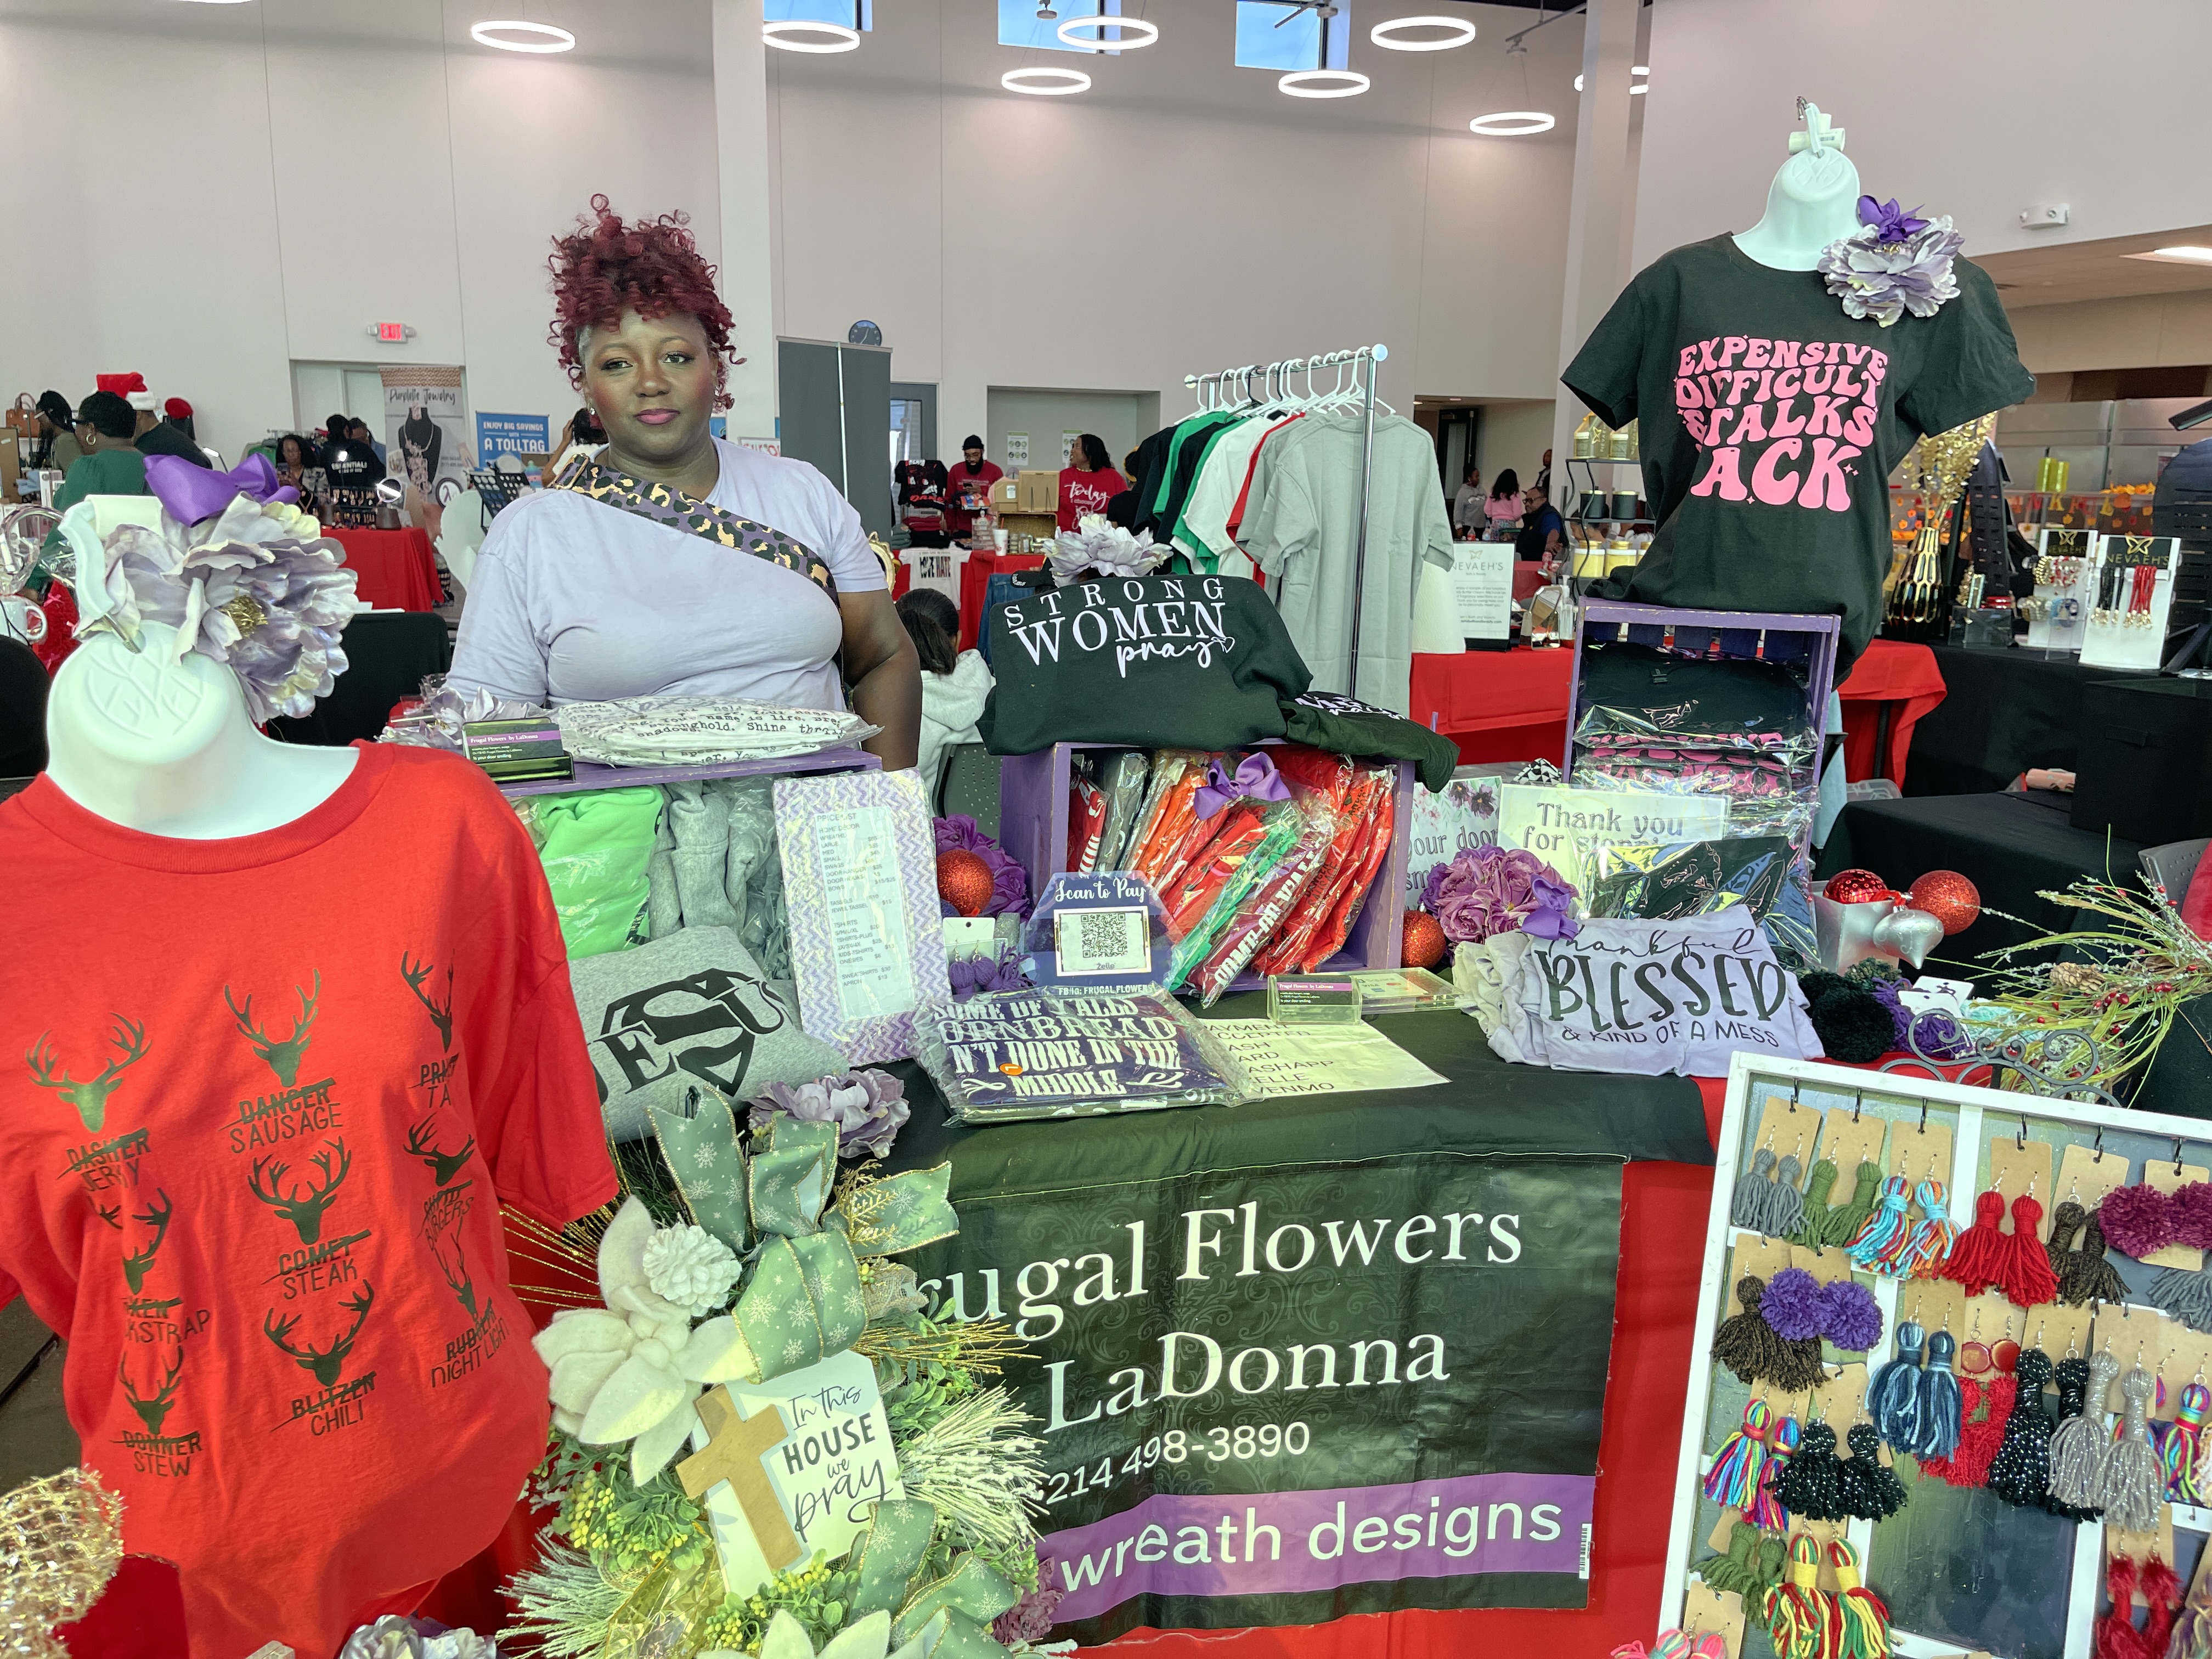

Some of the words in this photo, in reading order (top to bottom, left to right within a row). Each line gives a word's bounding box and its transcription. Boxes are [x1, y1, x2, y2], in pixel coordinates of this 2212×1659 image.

[381, 323, 402, 340] EXIT
[1677, 336, 1888, 380] EXPENSIVE
[1675, 364, 1877, 409] DIFFICULT
[483, 421, 503, 430] ENJOY
[504, 422, 515, 430] BIG
[516, 423, 544, 431] SAVINGS
[1703, 395, 1877, 448] TALKS
[484, 438, 493, 451] A
[495, 438, 545, 452] TOLLTAG
[1690, 437, 1863, 511] ACK
[1064, 482, 1110, 511] today
[2107, 554, 2169, 565] NEVAEH'S
[1004, 578, 1224, 629] STRONG
[1009, 601, 1226, 665] WOMEN
[1115, 635, 1215, 678] pray
[747, 722, 787, 732] Shine
[1537, 802, 1622, 834] Thank
[1632, 814, 1684, 840] you
[1457, 826, 1498, 850] door
[1523, 826, 1565, 852] for
[1055, 880, 1095, 902] Scan
[1093, 883, 1111, 899] to
[1113, 878, 1147, 903] Pay
[837, 933, 873, 943] TSHIRTS-PLUS
[839, 956, 864, 964] ONESIES
[843, 979, 862, 987] APRON
[1084, 986, 1115, 995] FRUGAL
[1535, 950, 1786, 1032] BLESSED
[937, 1018, 1178, 1043] ORNBREAD
[1217, 1031, 1311, 1040] CCEPTED
[1562, 1025, 1582, 1041] &
[1589, 1031, 1647, 1043] KIND
[1656, 1022, 1679, 1043] OF
[1690, 1024, 1706, 1041] A
[1716, 1023, 1780, 1047] MESS
[1003, 1040, 1087, 1072] DONE
[1087, 1039, 1124, 1064] IN
[1124, 1039, 1182, 1071] THE
[1229, 1042, 1271, 1051] ASH
[1238, 1052, 1279, 1062] ARD
[1249, 1060, 1334, 1073] ASHAPP
[1253, 1073, 1310, 1084] ELLE
[1007, 1069, 1128, 1096] MIDDLE
[239, 1086, 330, 1124] DANCER
[230, 1102, 343, 1154] SAUSAGE
[279, 1234, 353, 1275] COMET
[1176, 1200, 1523, 1281] Flowers
[283, 1258, 357, 1300] STEAK
[431, 1345, 482, 1389] NIGHT
[1041, 1331, 1452, 1435] LaDonna
[311, 1399, 364, 1436] CHILI
[787, 1394, 817, 1430] In
[782, 1412, 876, 1475] HOUSE
[133, 1451, 191, 1477] STEW
[827, 1457, 850, 1479] we
[1048, 1457, 1114, 1505] 214
[1120, 1421, 1310, 1476] 498-3890
[794, 1459, 893, 1543] pray
[1060, 1506, 1283, 1594] wreath
[1308, 1495, 1562, 1558] designs
